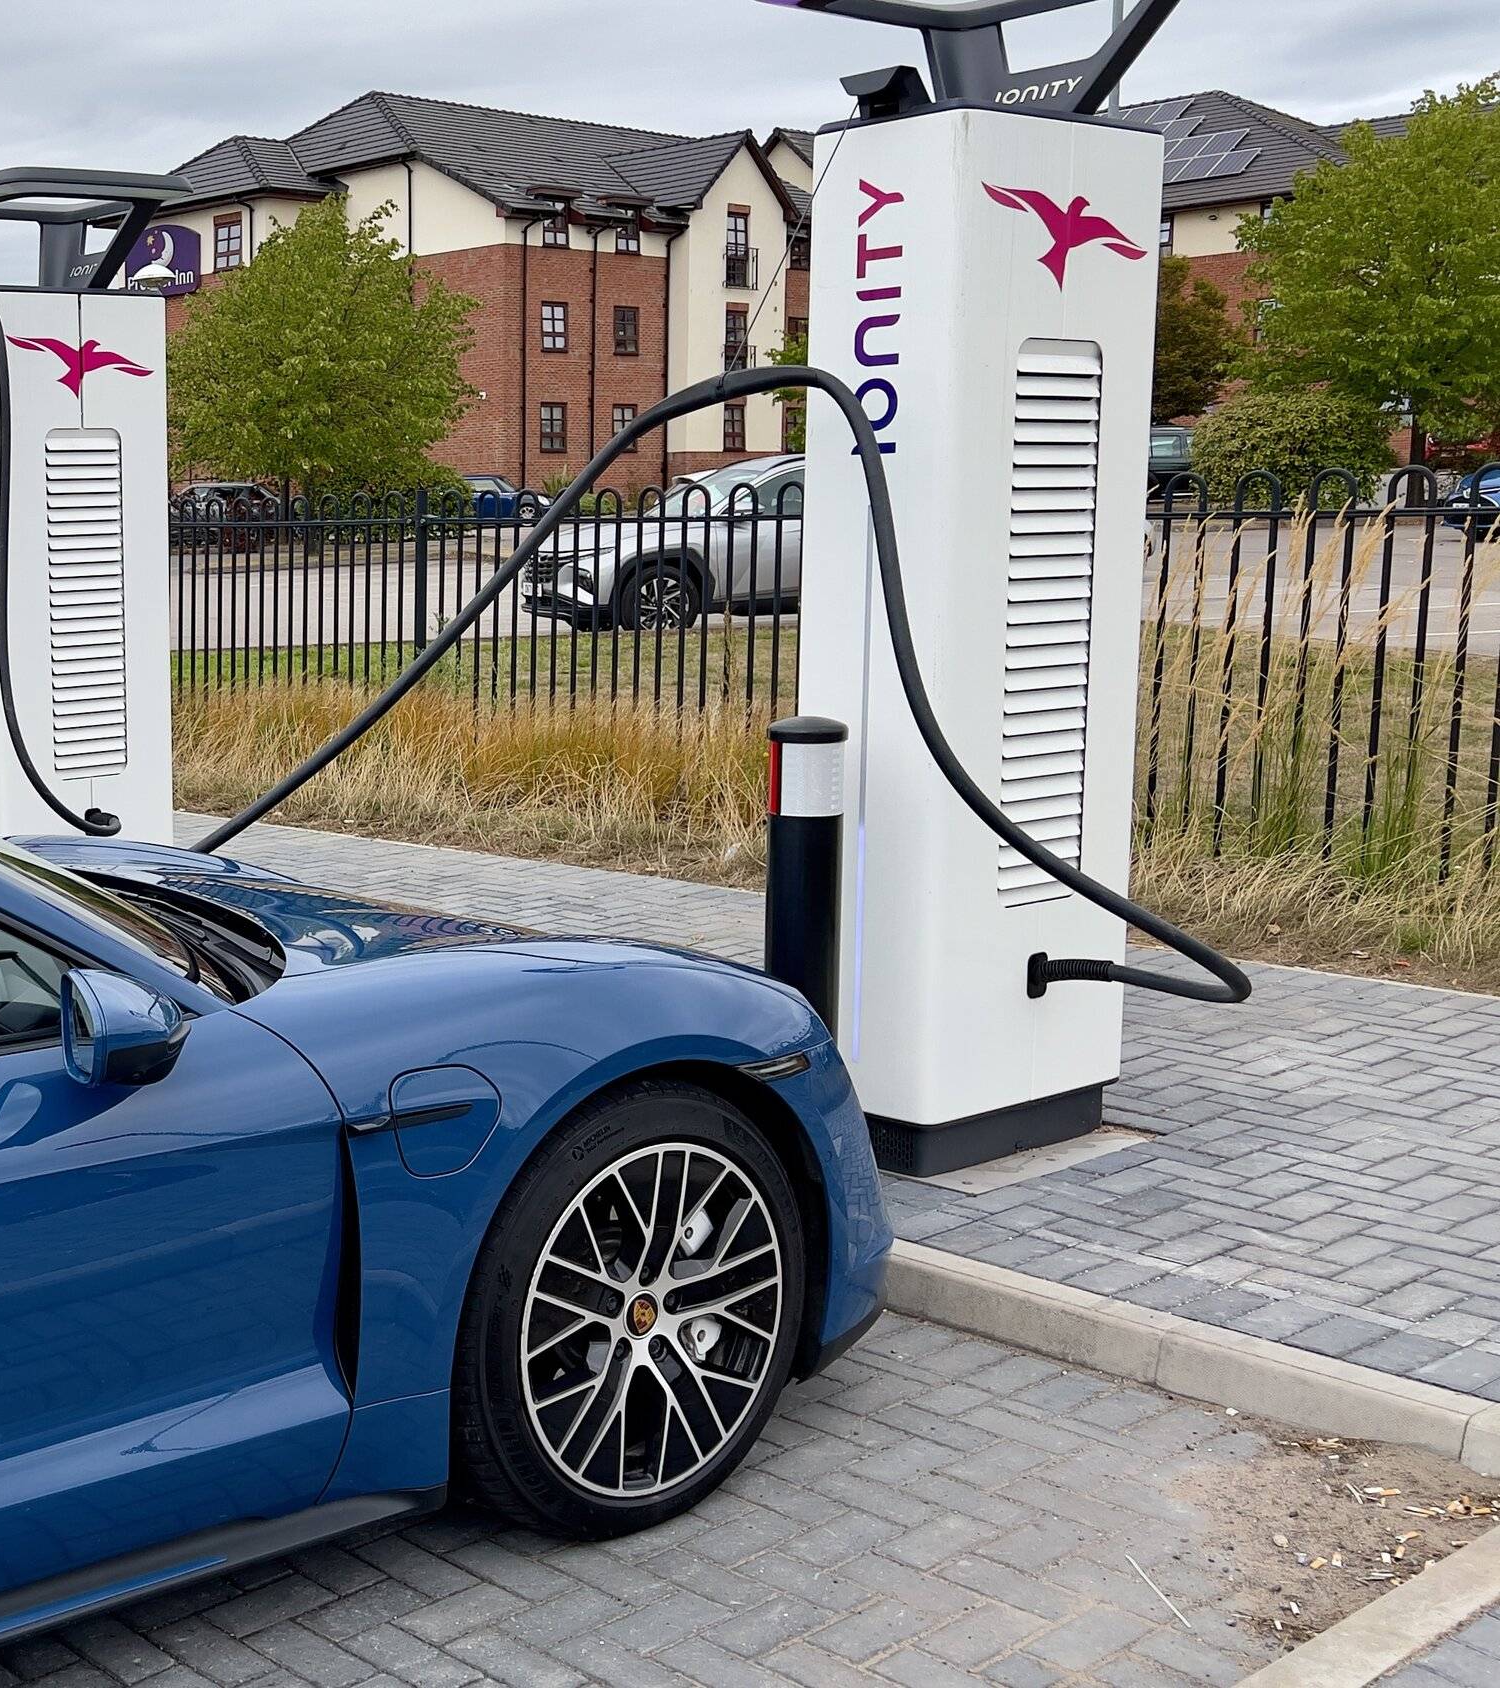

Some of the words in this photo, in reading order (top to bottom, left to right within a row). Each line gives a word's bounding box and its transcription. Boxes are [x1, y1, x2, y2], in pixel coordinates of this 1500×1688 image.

[994, 75, 1083, 105] IONITY
[69, 263, 98, 278] IONI
[175, 269, 194, 286] Inn
[851, 179, 905, 455] IONITY
